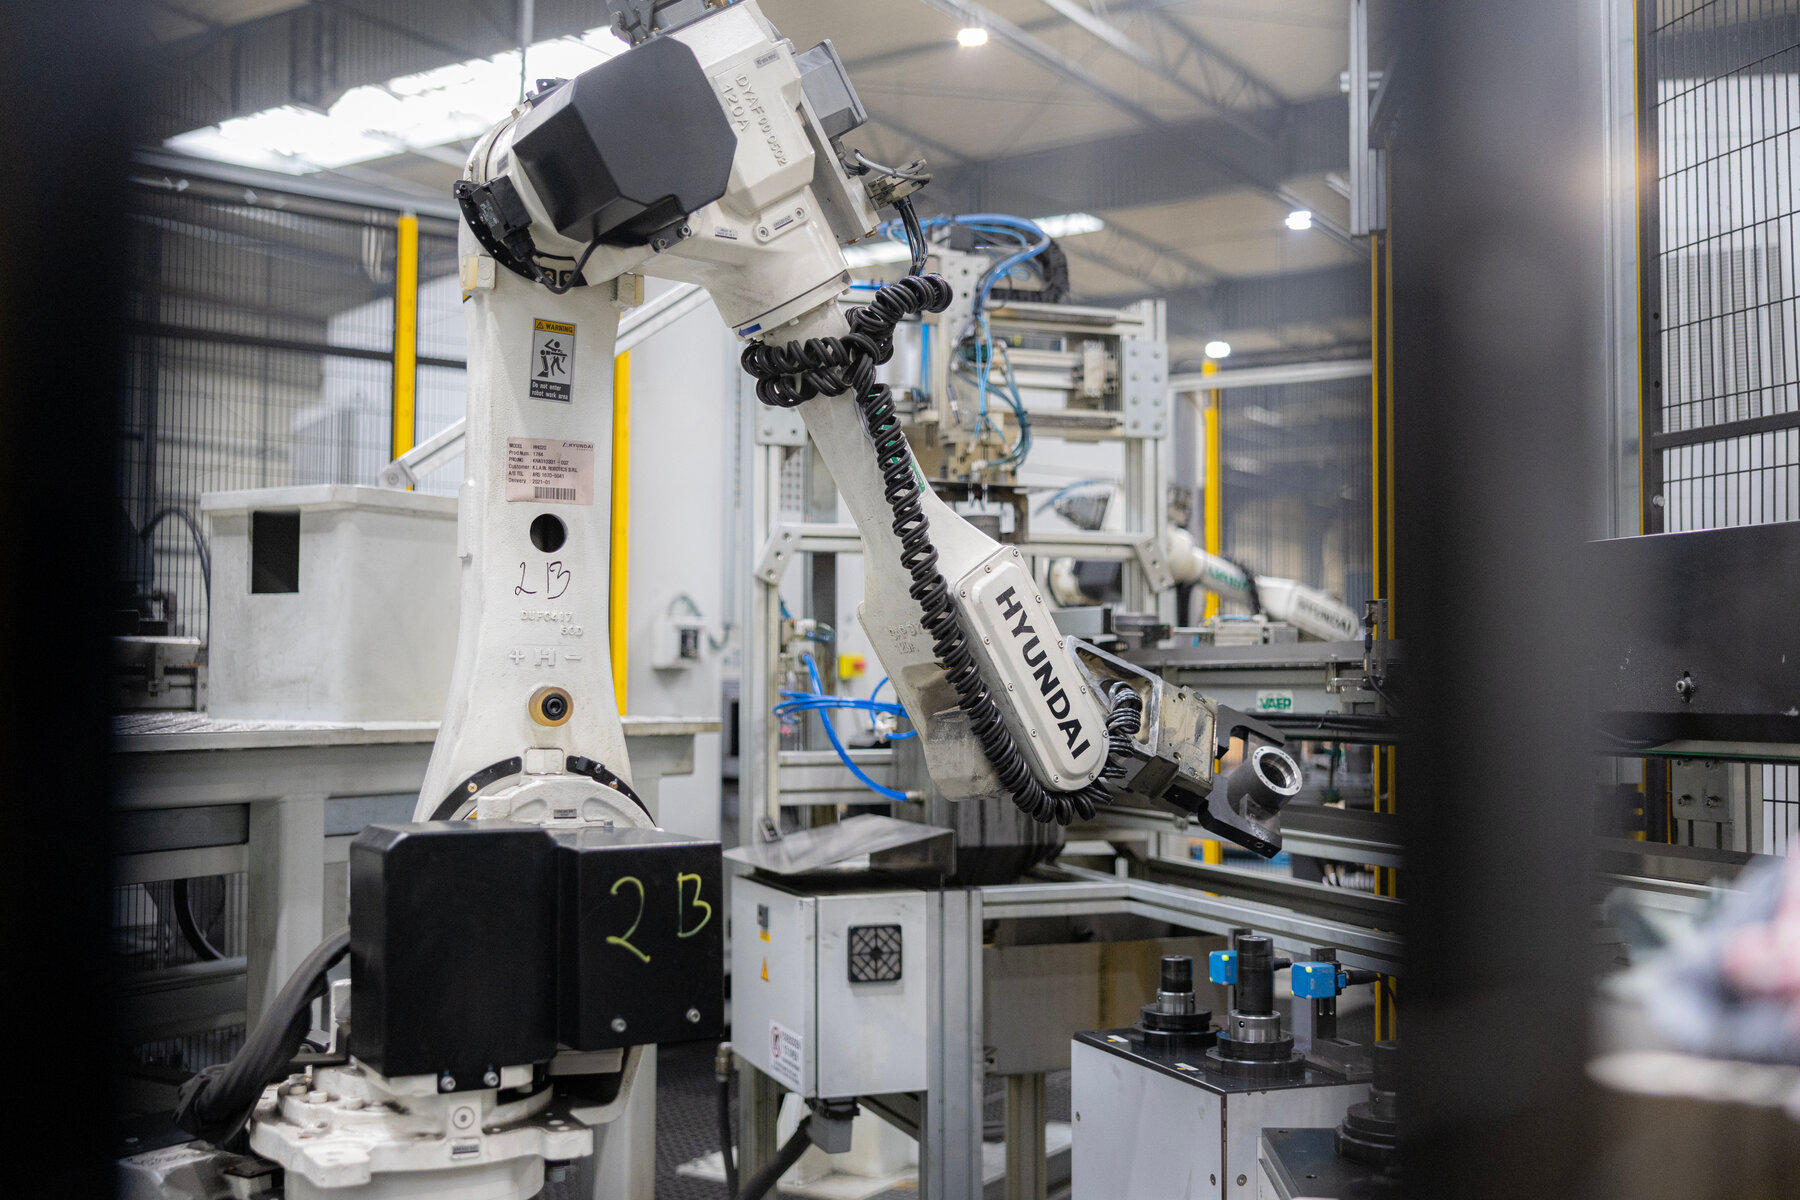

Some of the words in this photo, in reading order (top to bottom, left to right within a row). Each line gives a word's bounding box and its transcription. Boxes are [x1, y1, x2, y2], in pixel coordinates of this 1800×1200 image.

[720, 85, 751, 131] 120A
[545, 323, 573, 333] WARNING
[545, 391, 557, 399] work
[533, 647, 556, 667] H
[995, 585, 1091, 760] HYUNDAI
[605, 875, 652, 964] 2
[676, 872, 712, 939] B
